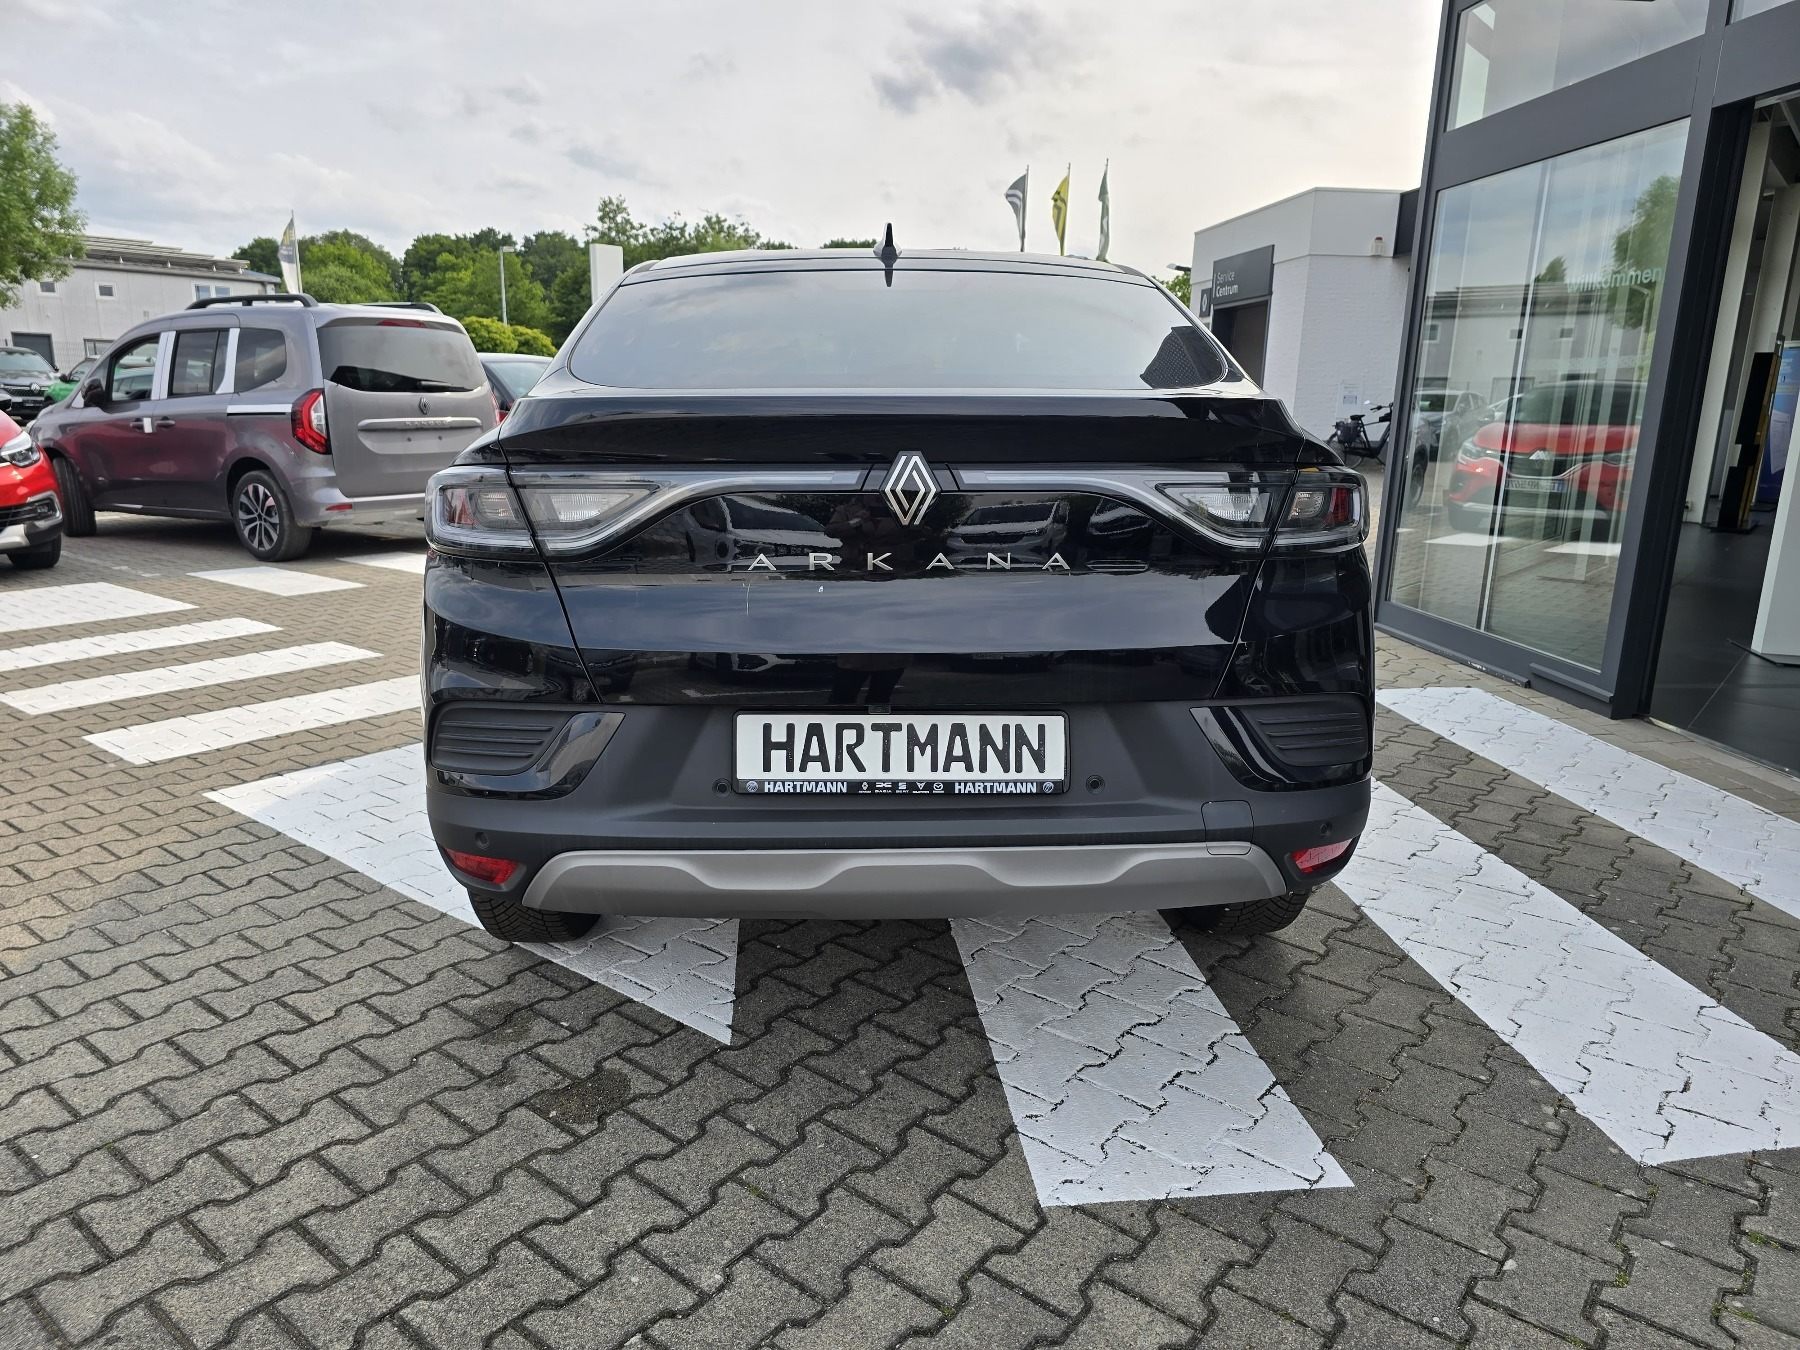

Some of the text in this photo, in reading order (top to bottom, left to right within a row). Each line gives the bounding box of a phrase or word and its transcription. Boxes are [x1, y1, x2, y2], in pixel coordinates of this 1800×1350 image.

[1217, 271, 1235, 284] Service
[1216, 284, 1239, 298] Centrum
[747, 552, 1071, 571] ARKANA
[762, 722, 1046, 773] HARTMANN
[764, 781, 847, 793] HARTMANN
[954, 782, 1037, 794] HARTMANN
